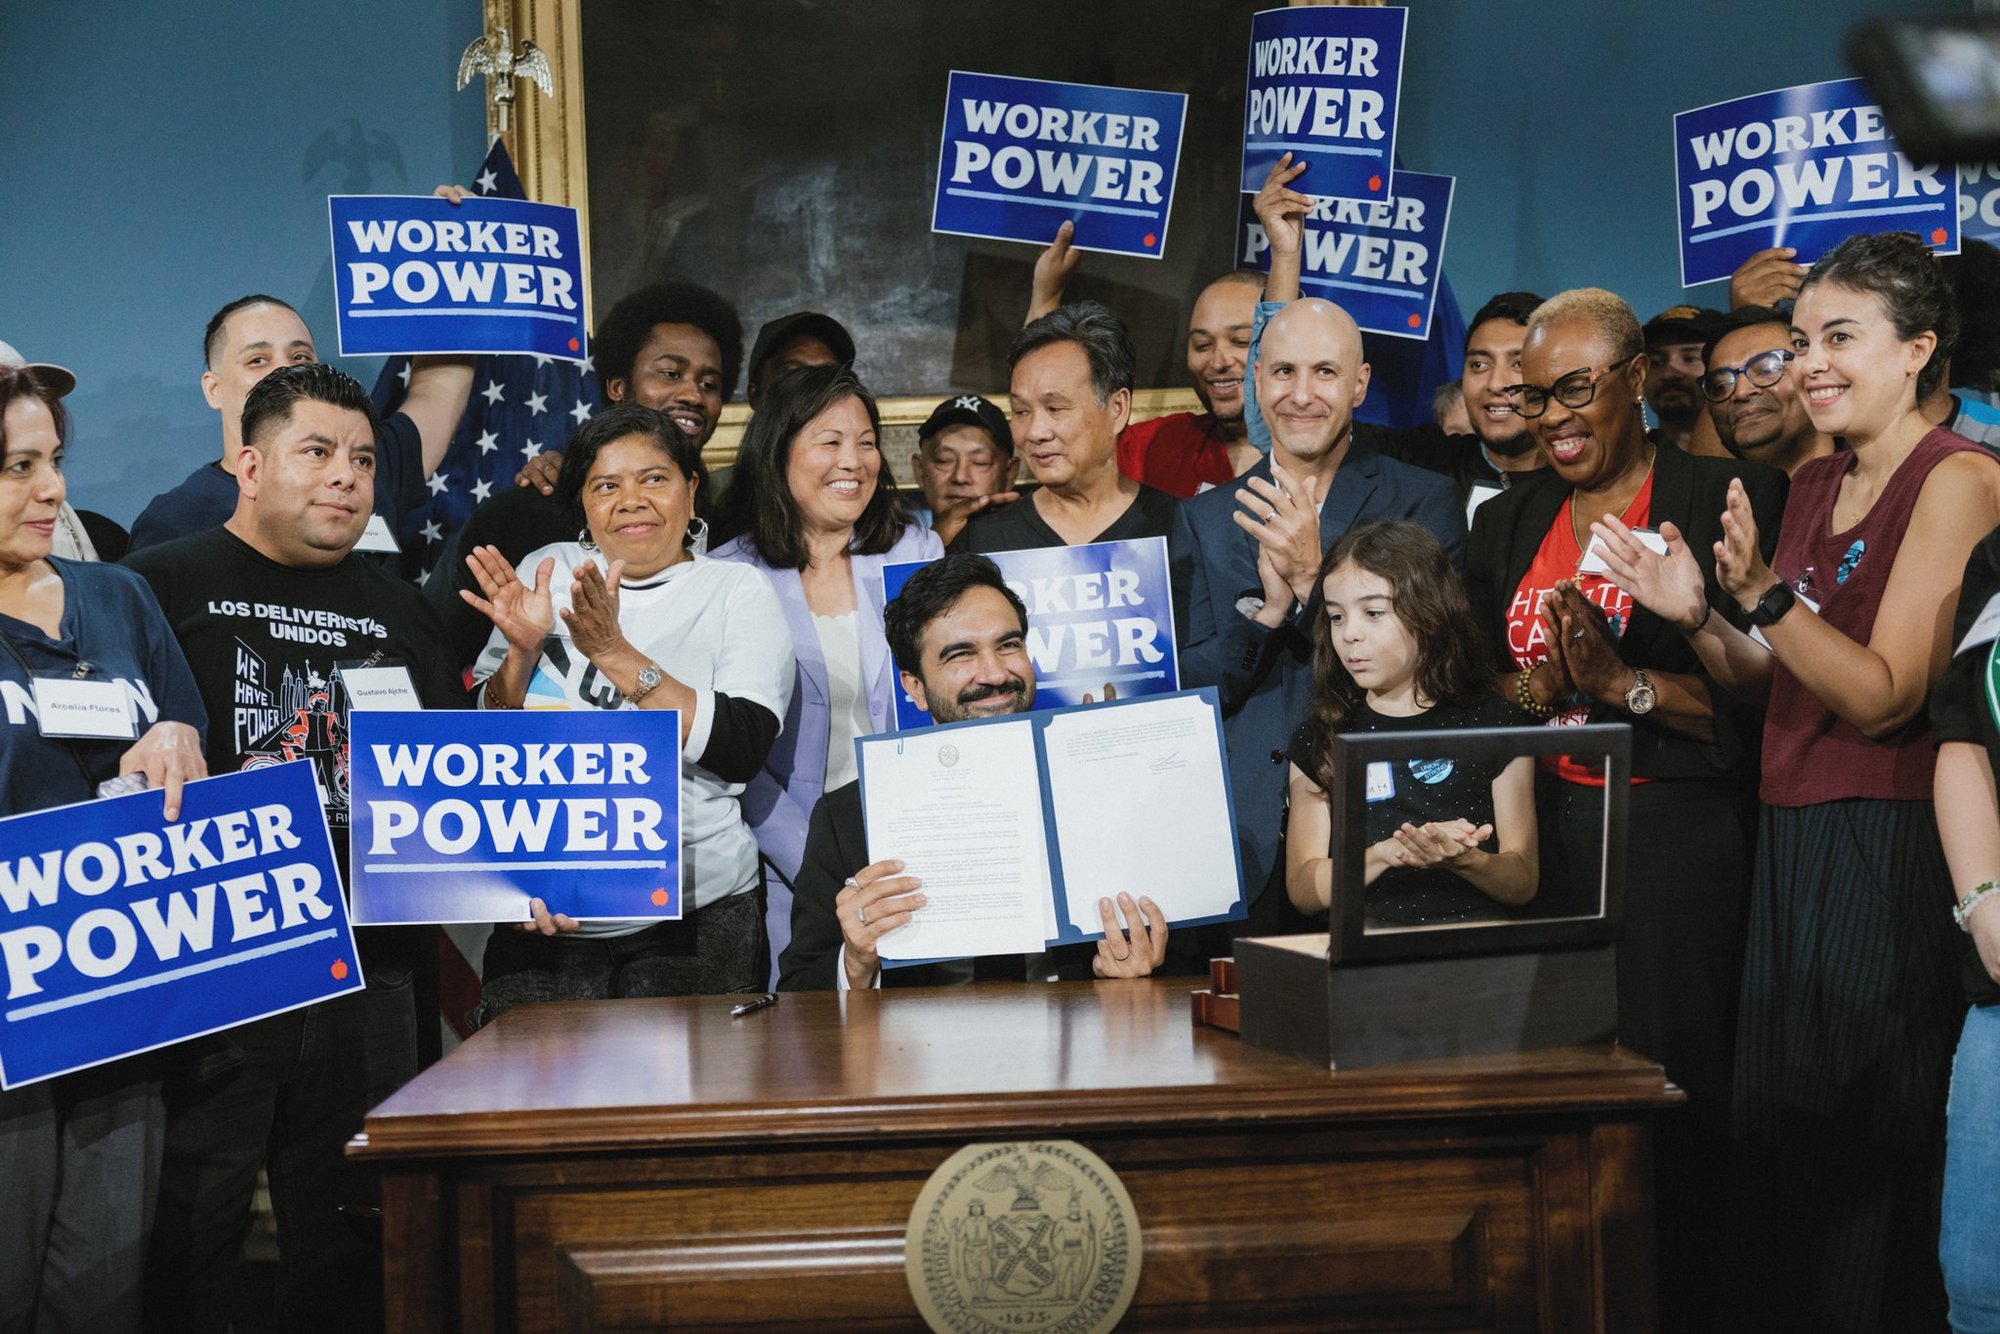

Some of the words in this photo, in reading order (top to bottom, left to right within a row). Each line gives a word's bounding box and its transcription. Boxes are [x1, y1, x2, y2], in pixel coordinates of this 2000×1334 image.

[1255, 36, 1379, 78] WORKER
[962, 98, 1160, 151] WORKER
[1248, 86, 1385, 140] POWER
[1690, 105, 1895, 171] WORKE
[950, 140, 1163, 205] POWER
[1306, 196, 1425, 232] RKER
[347, 219, 563, 259] WORKER
[1243, 223, 1429, 285] PWER
[347, 260, 577, 310] POWER
[208, 600, 251, 617] LOS
[254, 603, 388, 639] DELIVERISTAS
[269, 622, 347, 647] UNIDOS
[236, 647, 260, 685] WE
[1026, 617, 1164, 673] WER
[51, 702, 87, 711] Arcelia
[90, 704, 121, 713] Flores
[235, 679, 268, 706] HAVE
[234, 707, 280, 755] POWER
[370, 743, 651, 787] WORKER
[1420, 761, 1440, 771] UNION
[367, 798, 668, 855] POWER
[0, 804, 301, 913] WORKER
[0, 862, 333, 1000] POWER
